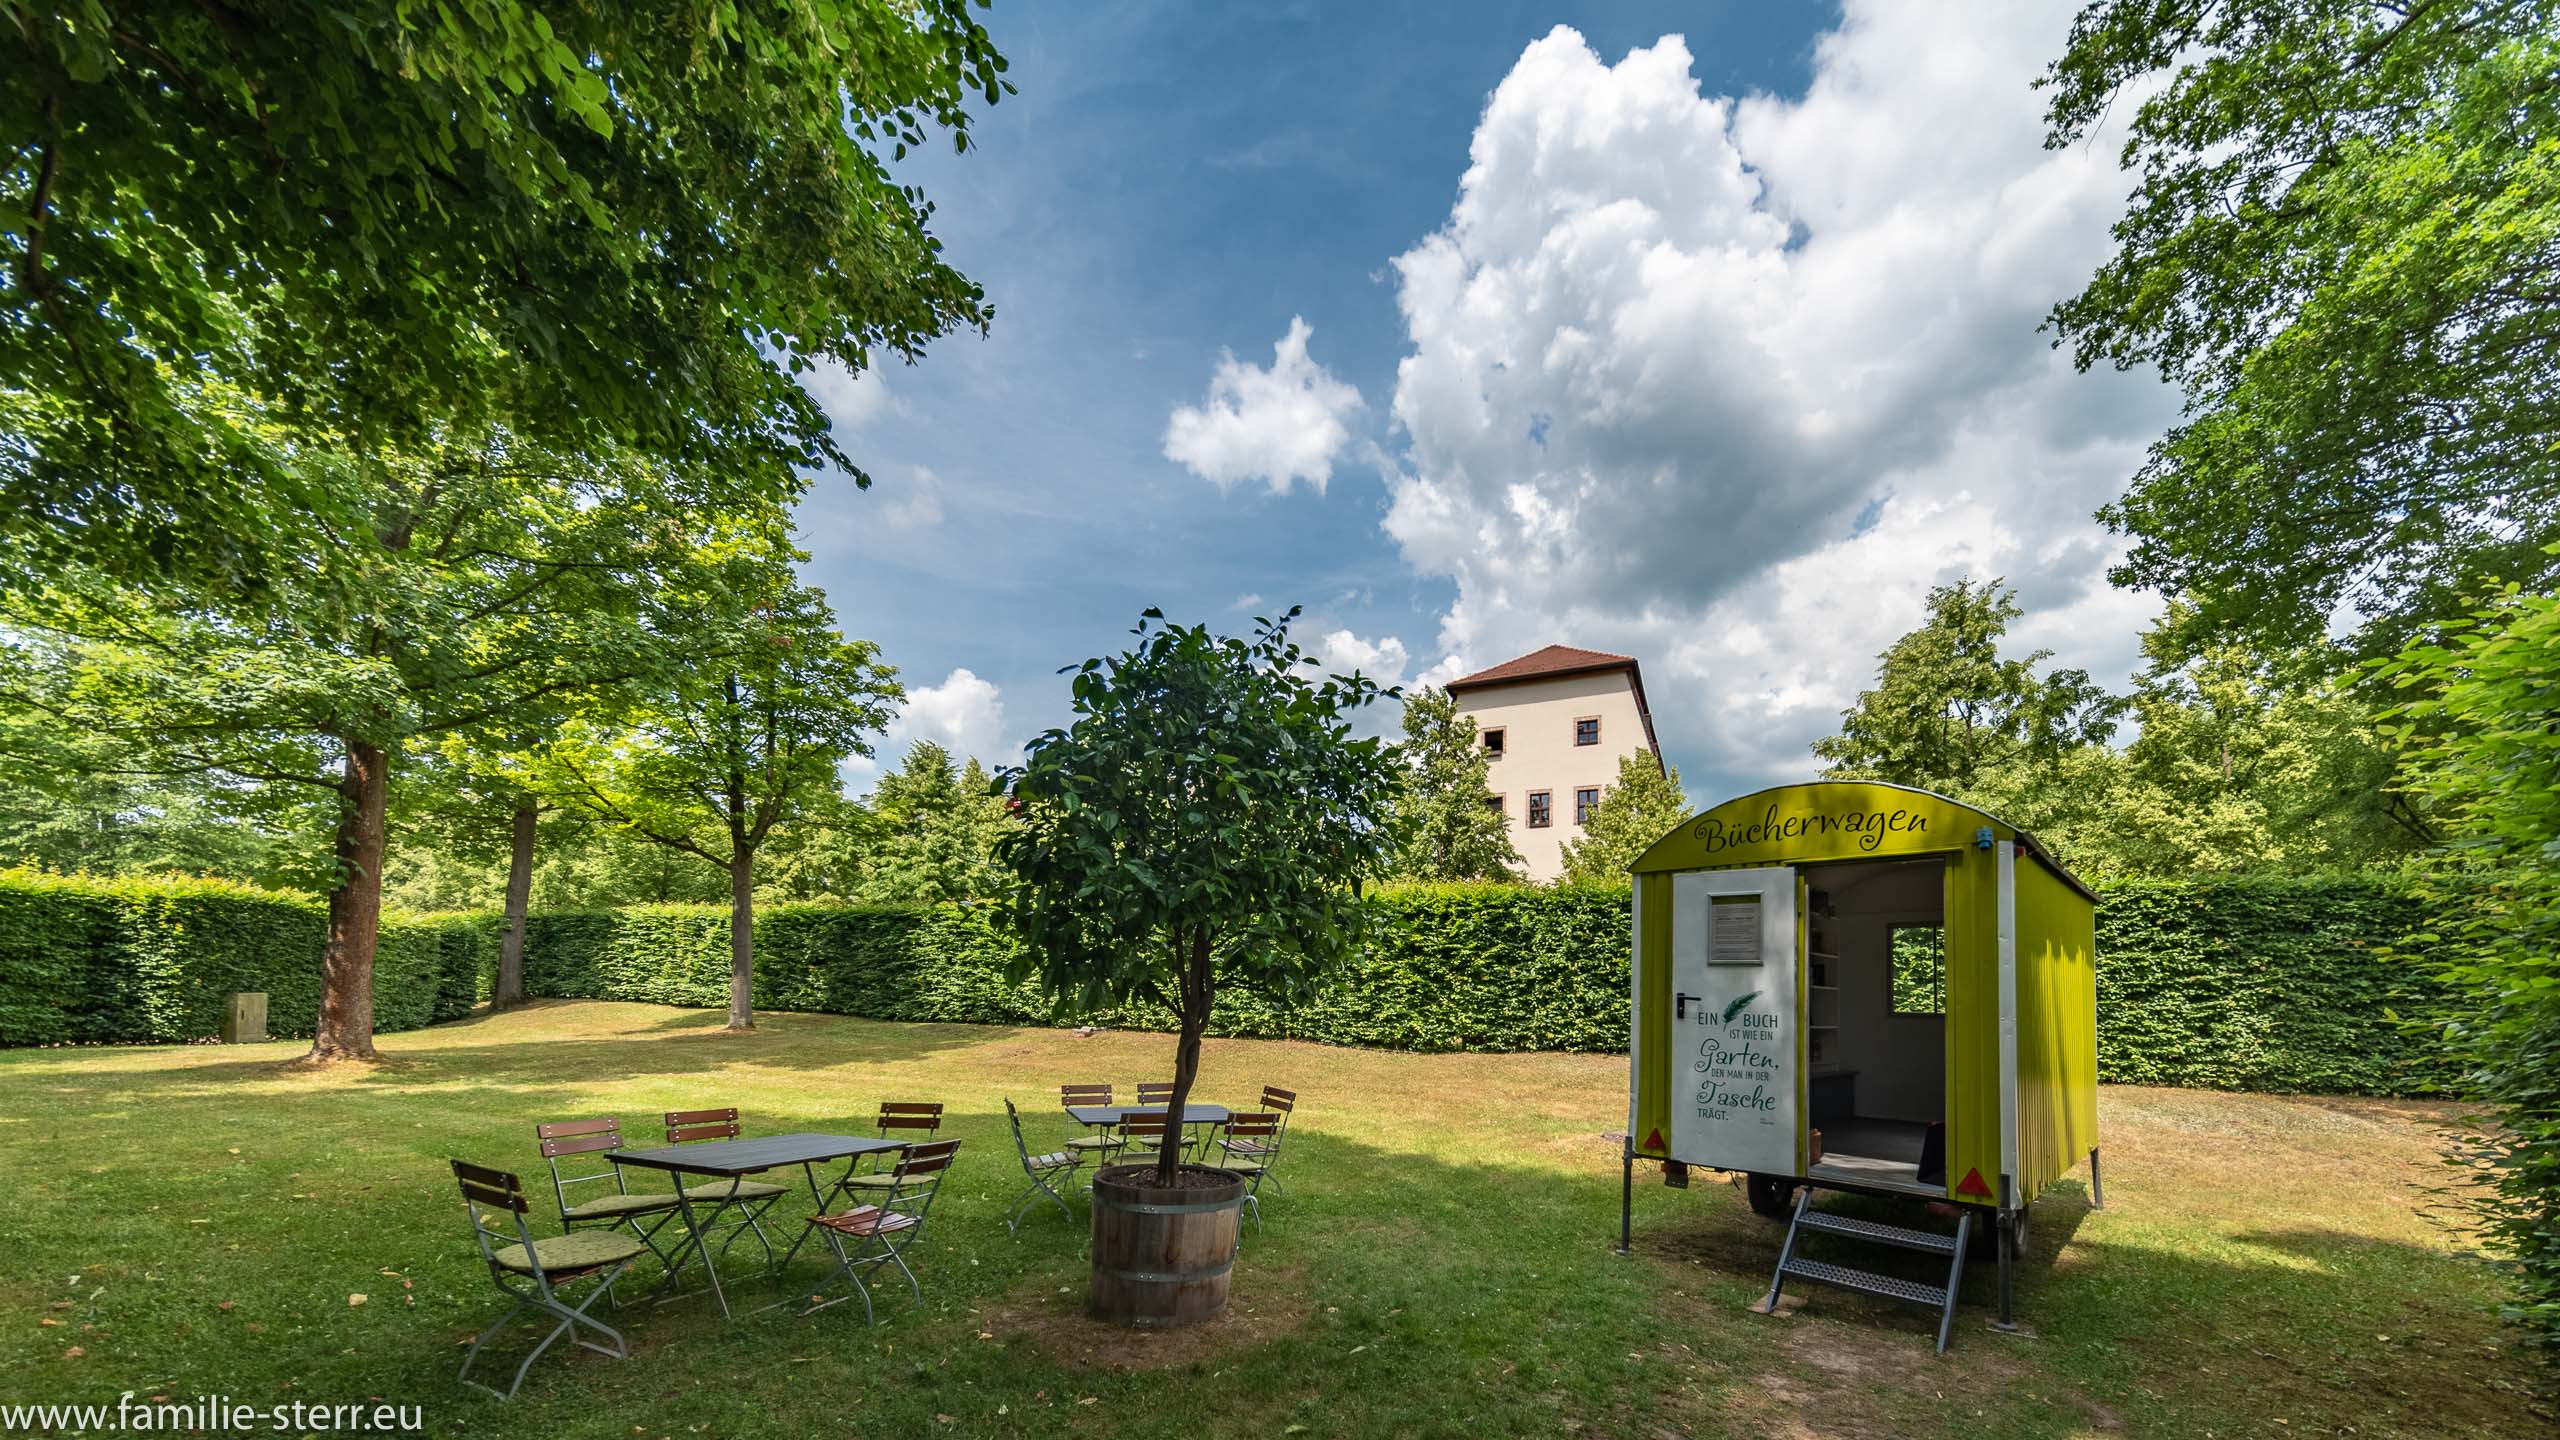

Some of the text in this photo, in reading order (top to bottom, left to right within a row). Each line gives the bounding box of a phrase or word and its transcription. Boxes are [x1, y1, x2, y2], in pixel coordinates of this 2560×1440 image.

[1694, 803, 1928, 853] Bücherwagen
[1698, 1012, 1778, 1028] EIN BUCH
[1729, 1029, 1773, 1041] IST WIE EIN
[1711, 1068, 1769, 1081] DEN MAN IN DER
[1696, 1080, 1776, 1111] Tasche
[1697, 1108, 1729, 1121] TRÄGT.
